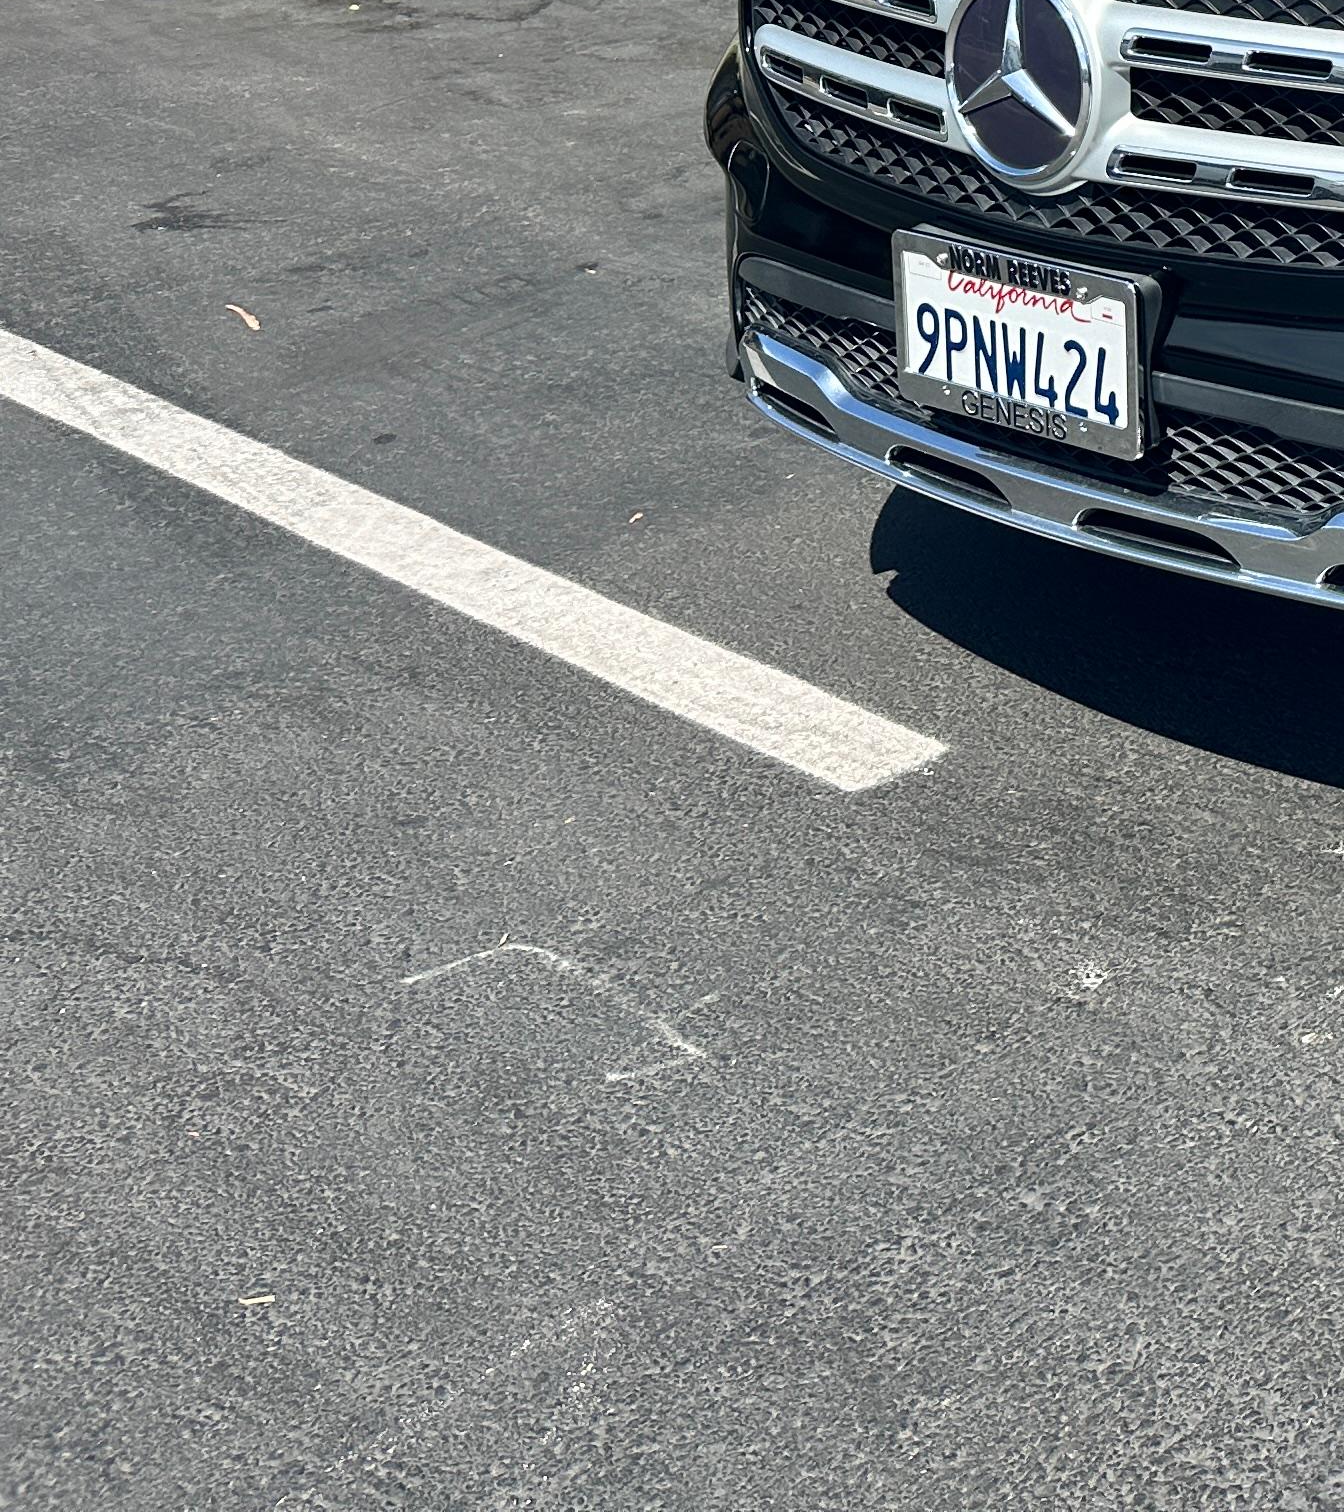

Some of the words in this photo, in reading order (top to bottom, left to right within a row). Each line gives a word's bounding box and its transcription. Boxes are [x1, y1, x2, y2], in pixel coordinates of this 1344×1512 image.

[947, 269, 1092, 323] California
[948, 244, 1002, 281] NORM
[1006, 258, 1072, 296] REEVES
[916, 302, 1120, 425] 9PNW424
[961, 389, 1068, 440] GENESIS
